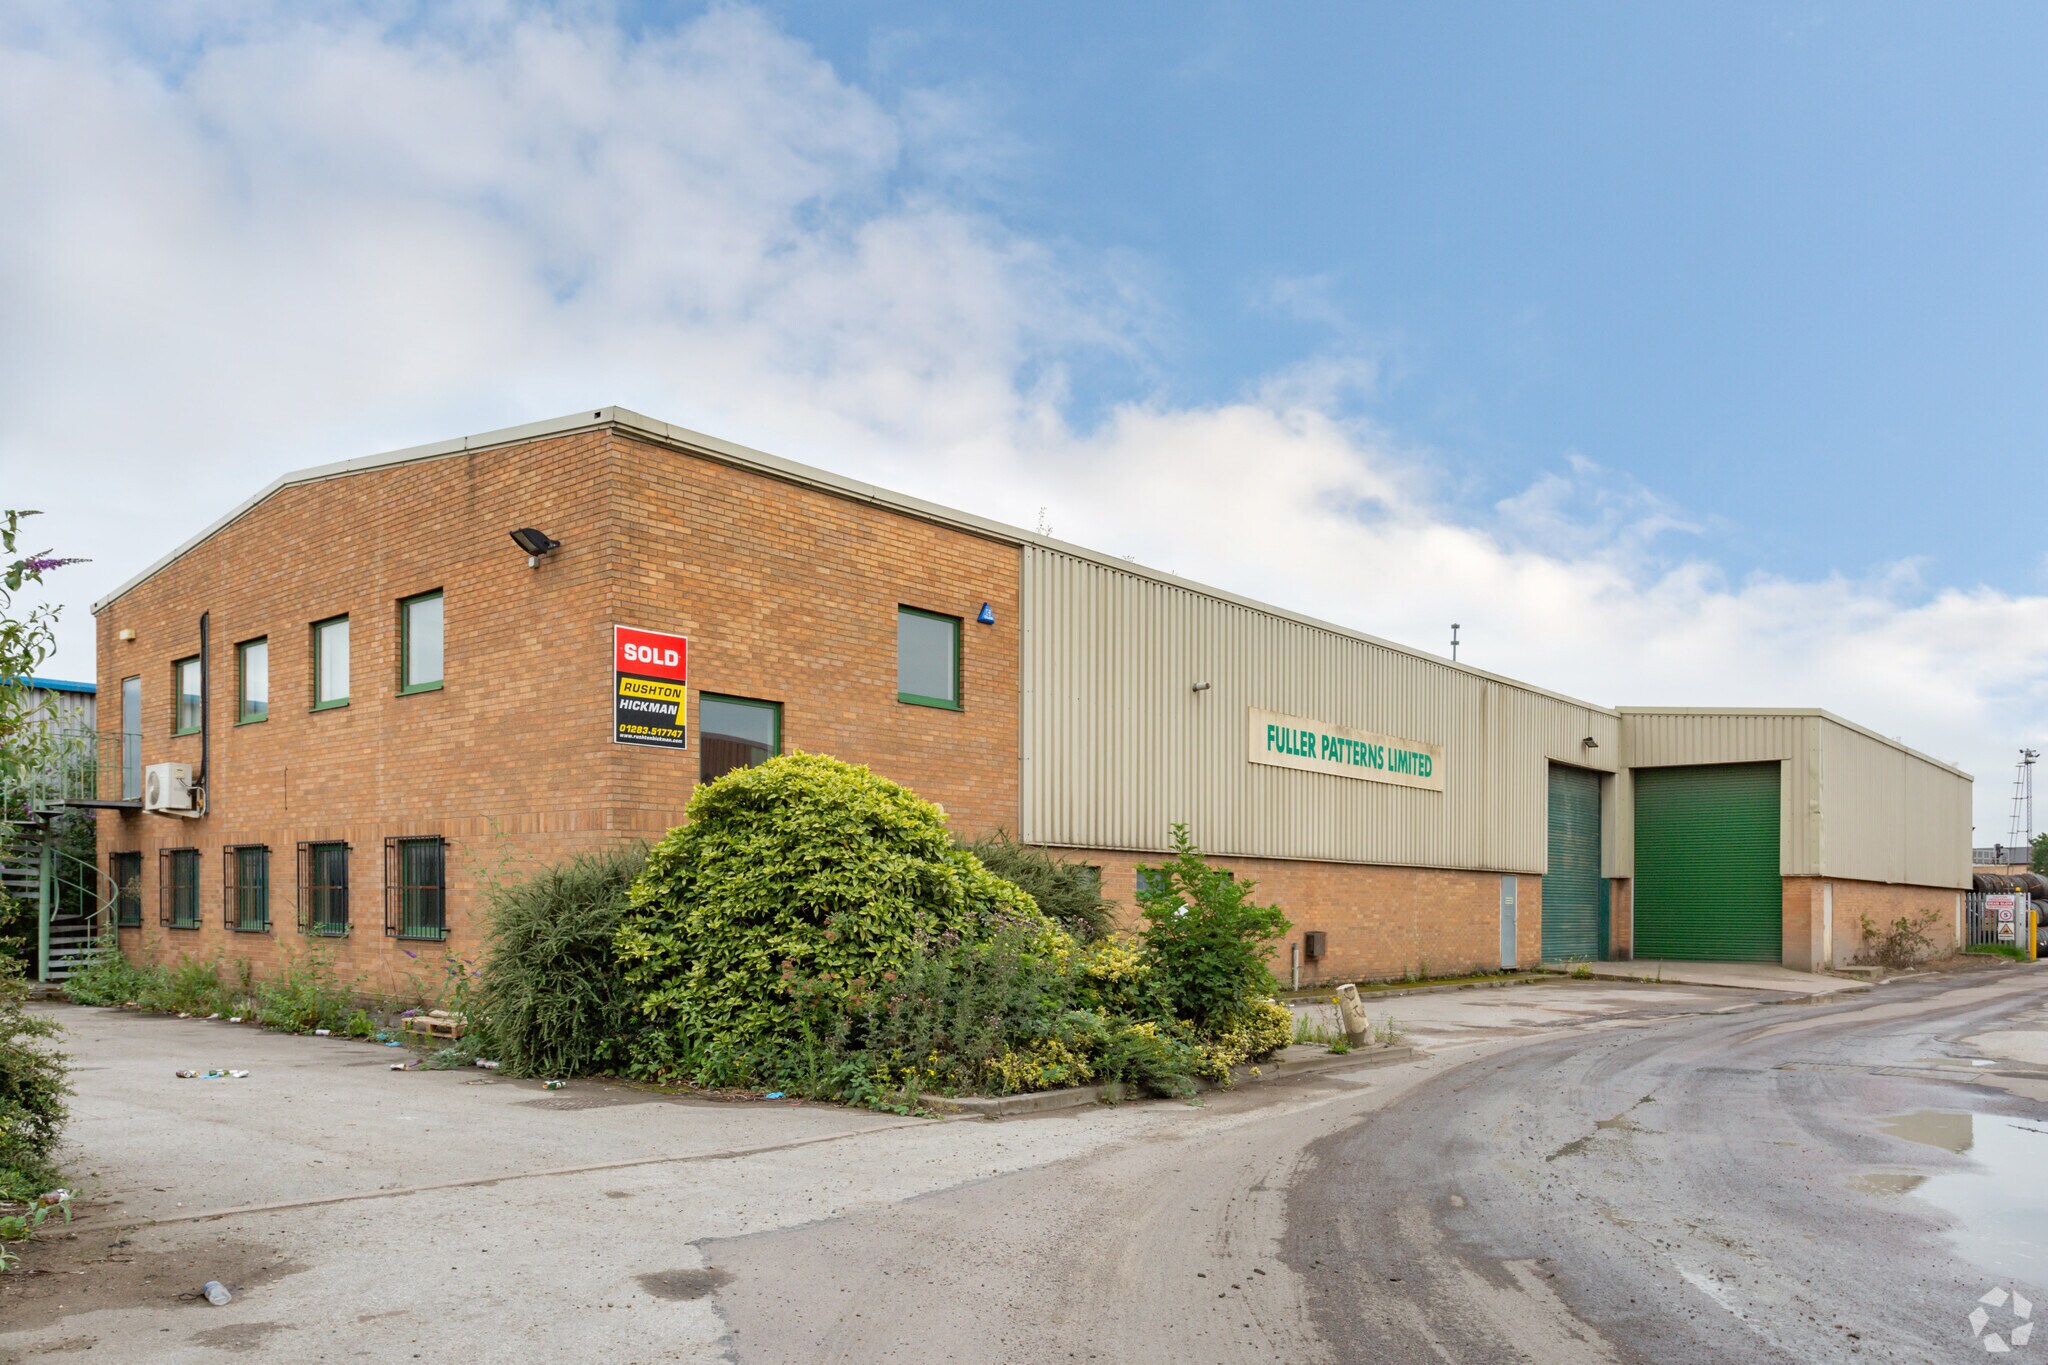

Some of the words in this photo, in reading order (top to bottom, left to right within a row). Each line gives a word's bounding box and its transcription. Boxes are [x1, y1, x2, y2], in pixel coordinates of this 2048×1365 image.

[624, 643, 679, 667] SOLD
[624, 682, 682, 698] RUSHTON
[619, 698, 678, 715] HICKMAN
[1267, 724, 1317, 759] FULLER
[1321, 734, 1384, 770] PATTERNS
[1388, 747, 1433, 778] LIMITED
